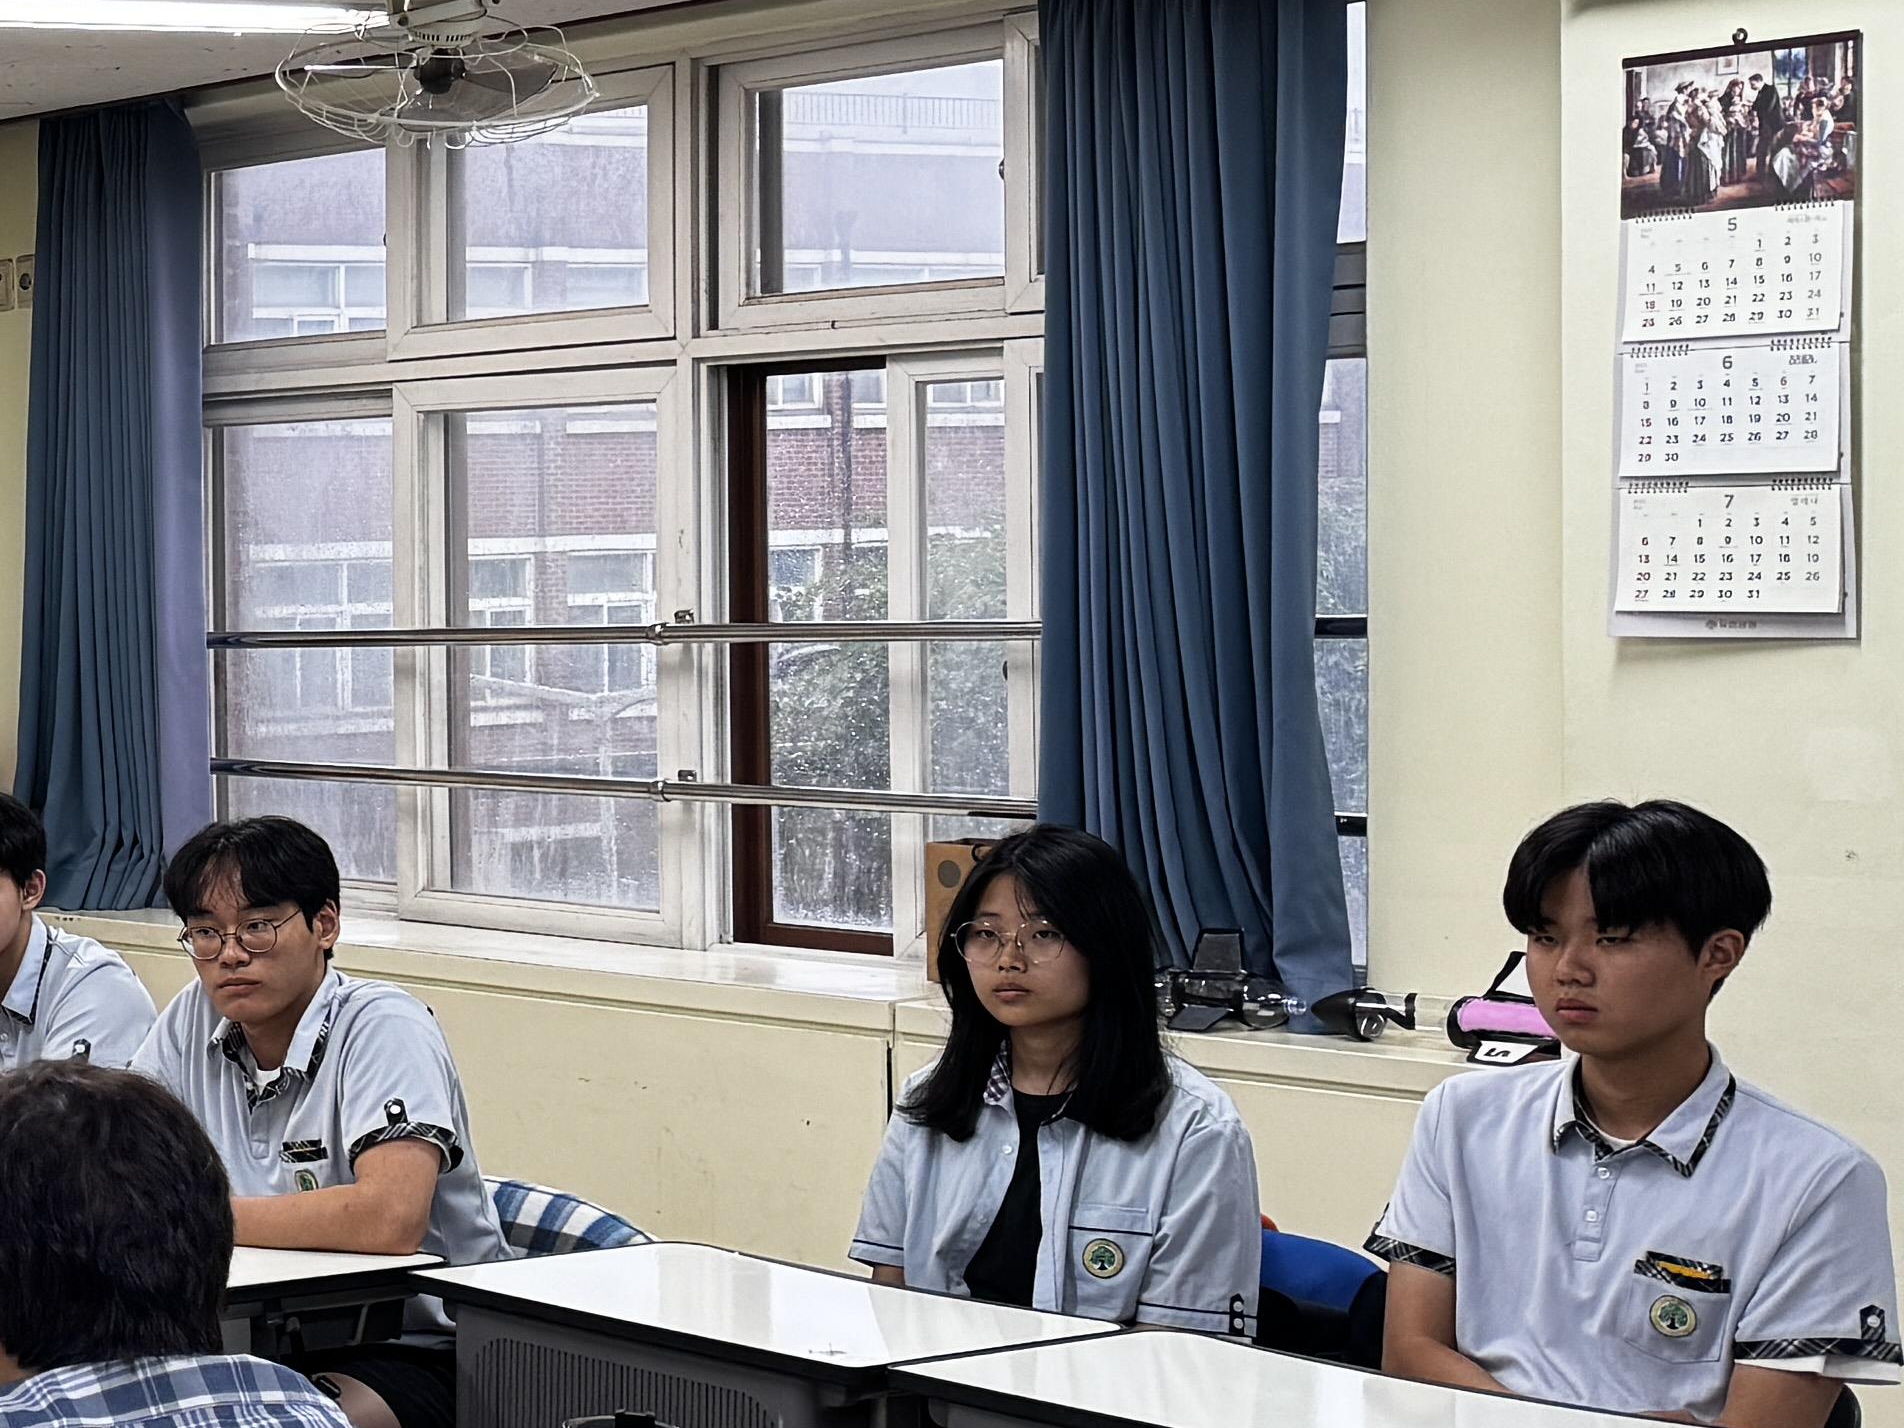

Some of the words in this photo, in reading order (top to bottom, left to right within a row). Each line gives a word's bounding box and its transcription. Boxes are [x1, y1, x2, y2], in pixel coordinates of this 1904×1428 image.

[1728, 217, 1737, 231] 5
[1723, 356, 1732, 369] 6
[1724, 495, 1734, 508] 7
